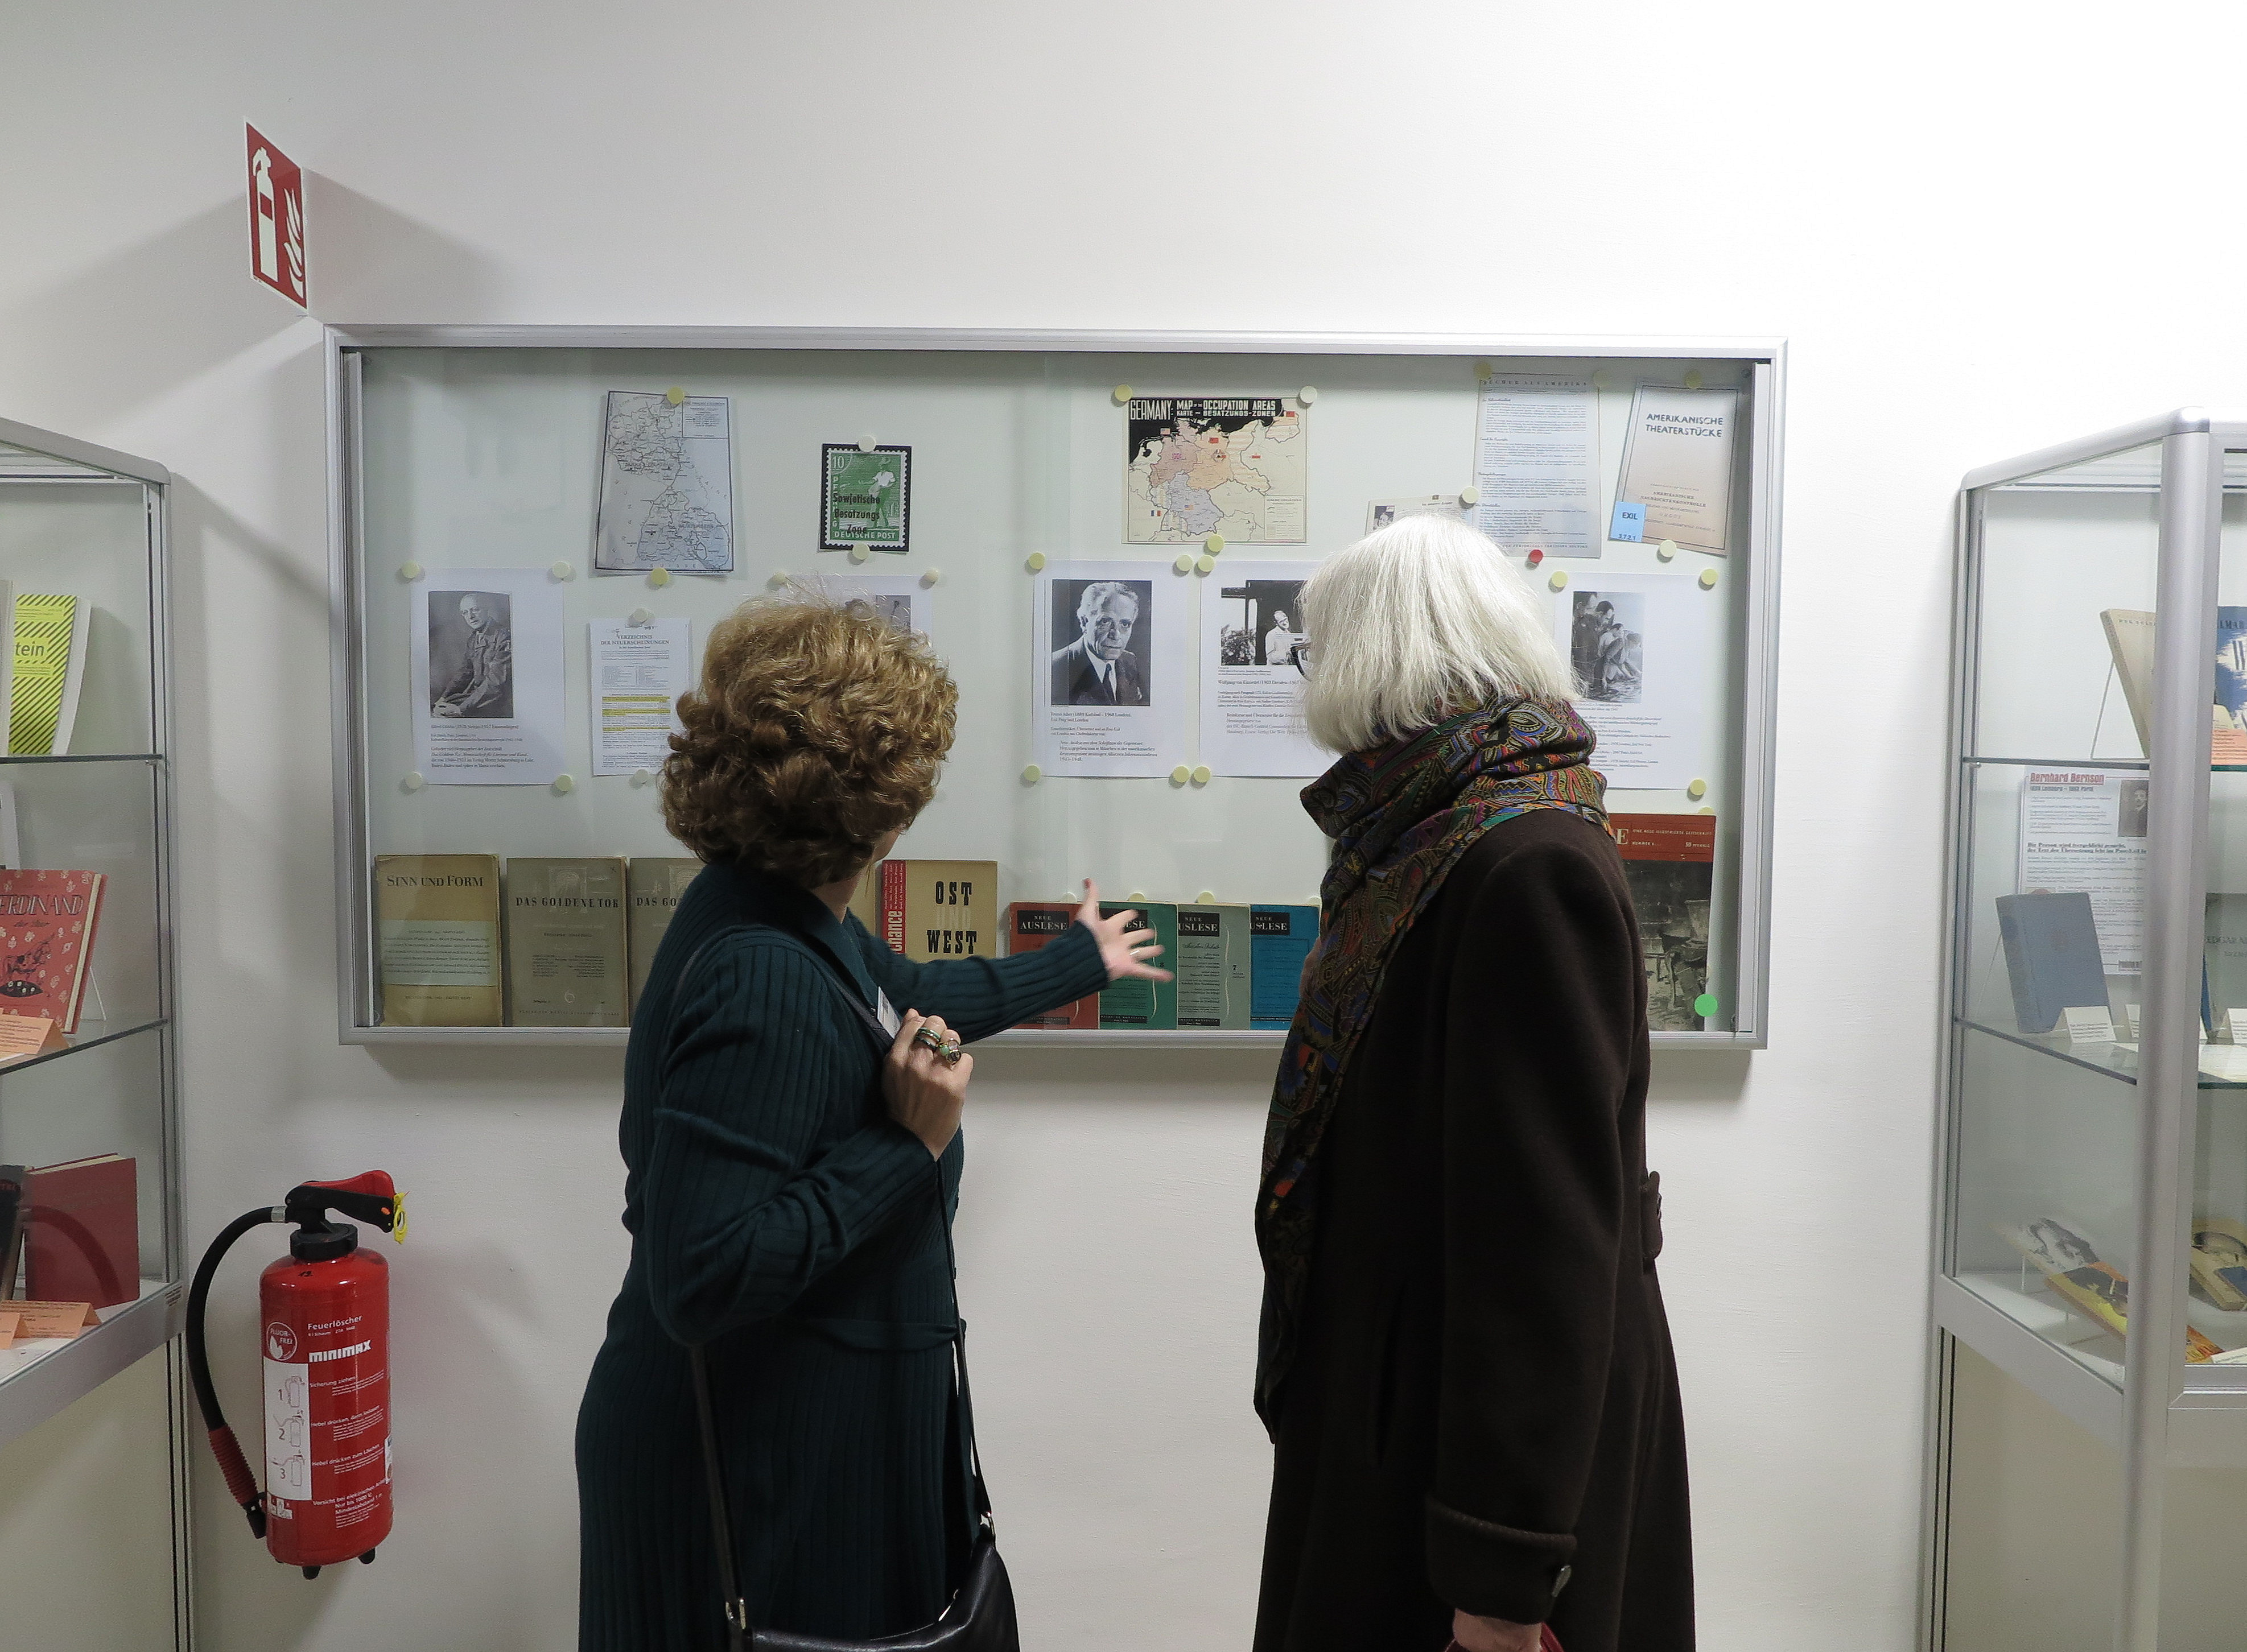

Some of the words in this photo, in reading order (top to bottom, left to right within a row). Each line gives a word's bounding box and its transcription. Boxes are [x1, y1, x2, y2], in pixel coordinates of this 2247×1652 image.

[1176, 400, 1193, 410] MAP
[1203, 400, 1248, 410] OCCUPATION
[1252, 400, 1276, 410] AREAS
[1646, 413, 1723, 426] AMERIKANISCHE
[1646, 424, 1722, 437] THEATERSTÜCKE
[832, 456, 844, 469] 10
[832, 493, 880, 505] Sowjetische
[834, 509, 880, 521] Besatzungs
[1622, 511, 1638, 520] EXIL
[847, 524, 867, 534] Zone
[15, 641, 45, 657] tein
[2030, 773, 2069, 782] Bernhard
[2071, 773, 2105, 783] Bernson
[1616, 828, 1628, 845] E
[447, 875, 484, 887] FORM
[935, 881, 972, 906] OST
[516, 897, 537, 907] DAS
[542, 897, 595, 908] GOLDENE
[598, 898, 619, 908] TOR
[636, 897, 658, 907] DAS
[662, 897, 677, 907] GO
[1020, 922, 1067, 930] AUSLESE
[926, 930, 978, 955] WEST
[308, 1315, 363, 1330] Feuerlöscher
[278, 1389, 283, 1401] 1
[278, 1428, 285, 1440] 2
[280, 1468, 286, 1479] 3
